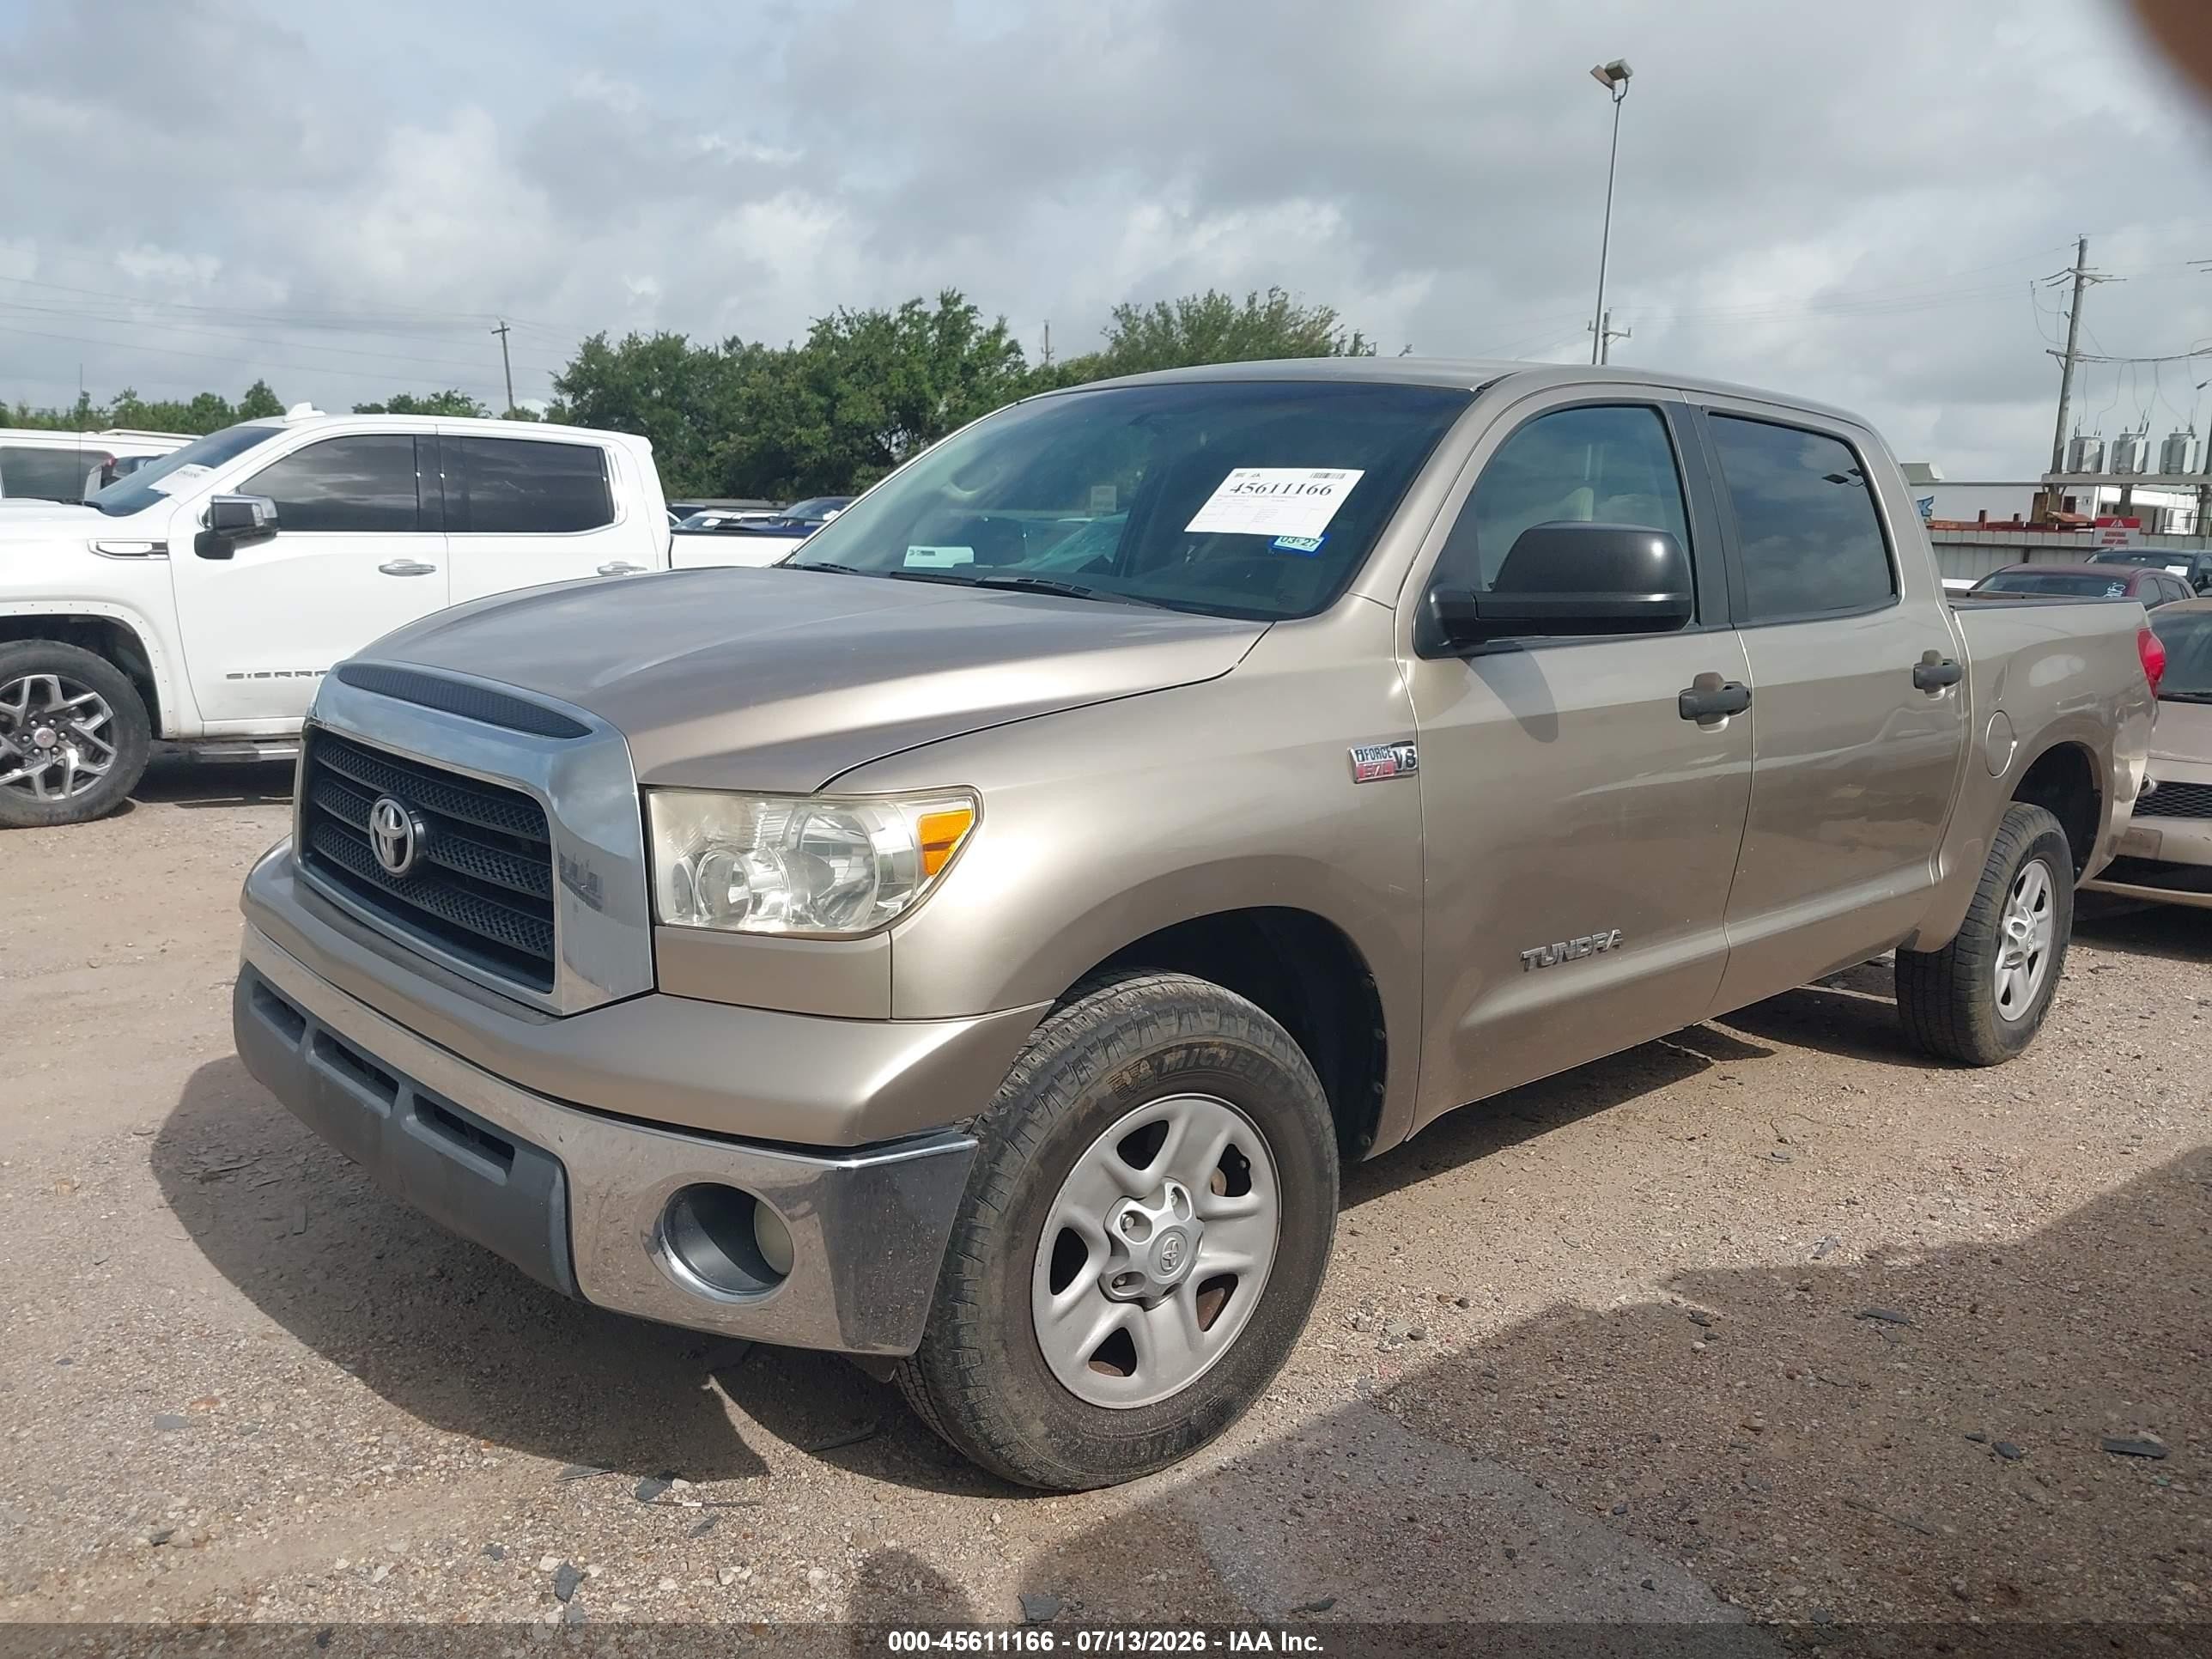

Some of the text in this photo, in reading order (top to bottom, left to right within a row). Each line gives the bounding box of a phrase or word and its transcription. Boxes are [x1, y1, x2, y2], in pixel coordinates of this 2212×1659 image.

[1229, 482, 1337, 496] 45611166
[1393, 748, 1417, 769] V8
[1520, 928, 1623, 972] TUNDRA
